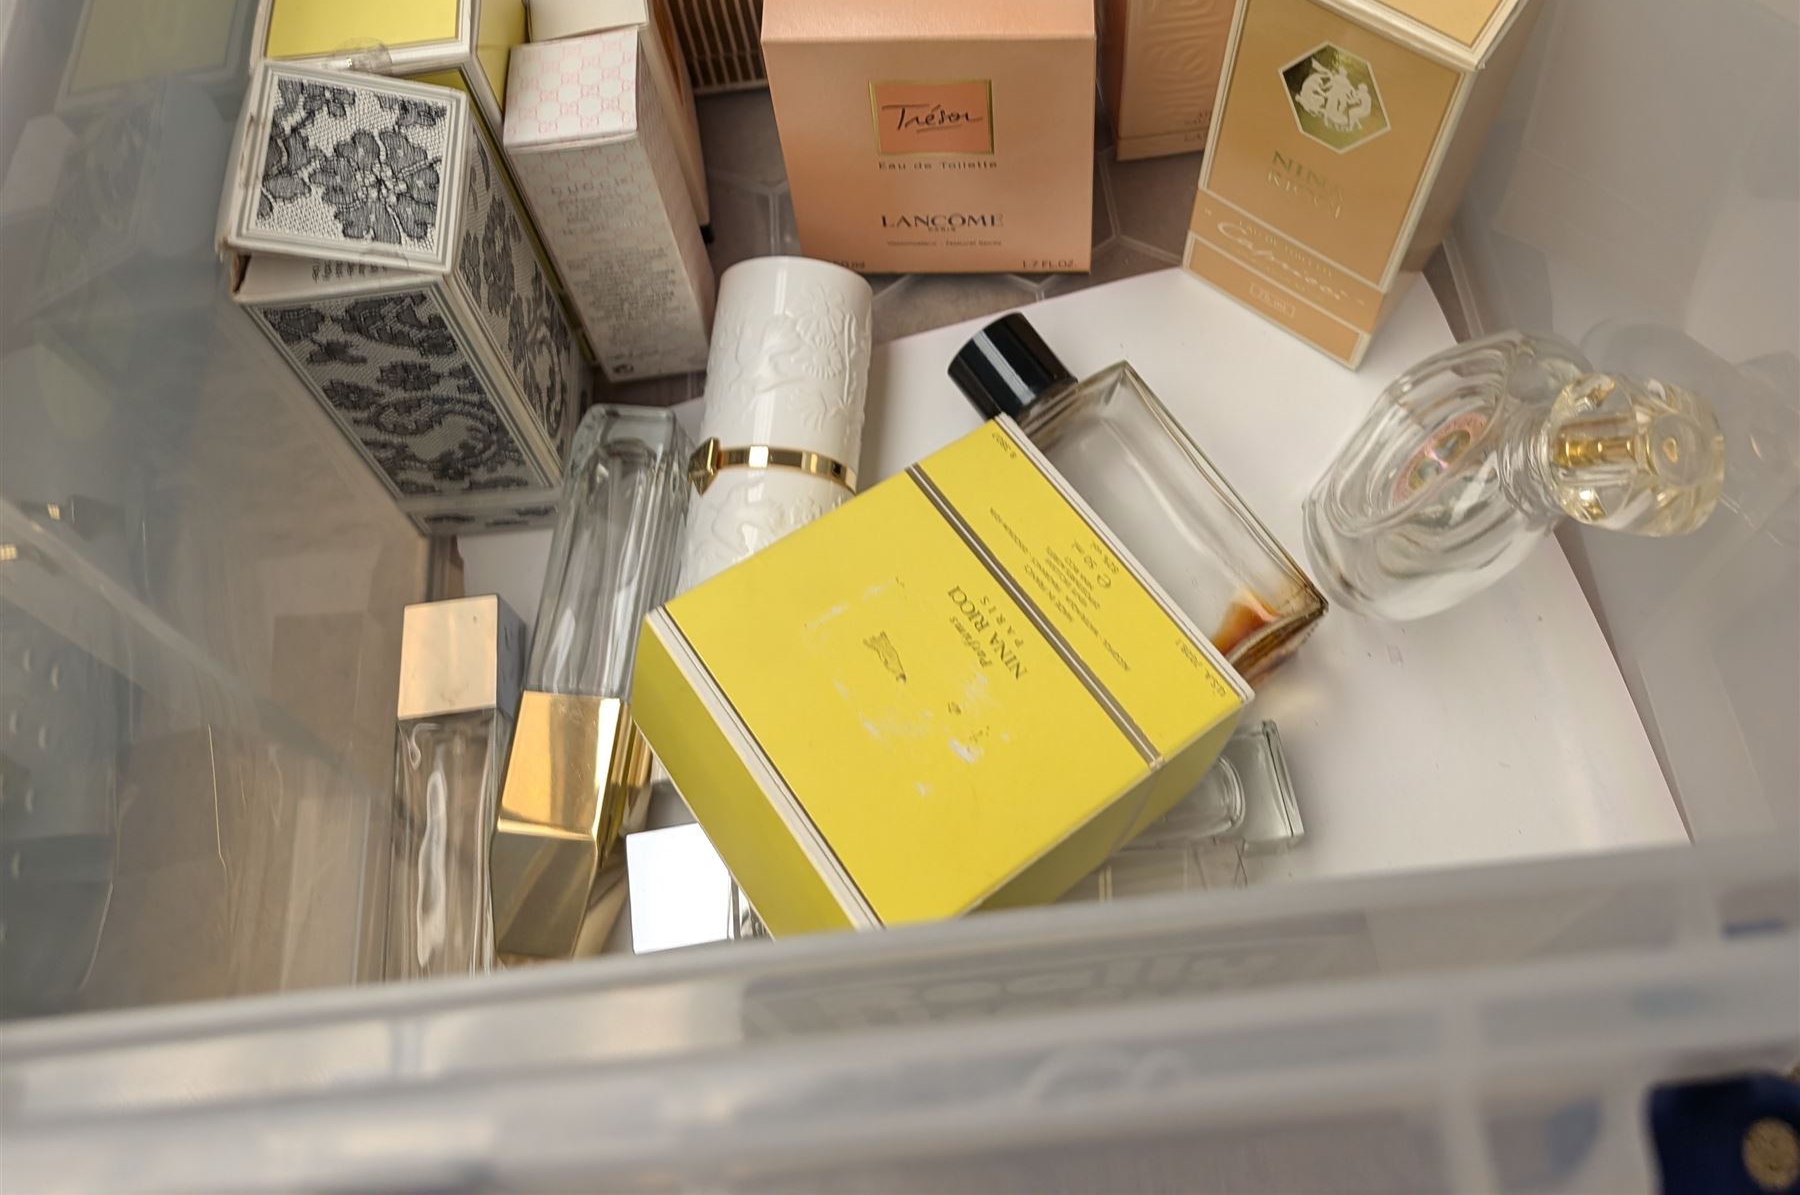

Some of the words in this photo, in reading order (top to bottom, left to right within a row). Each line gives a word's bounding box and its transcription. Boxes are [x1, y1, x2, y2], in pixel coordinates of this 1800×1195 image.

[882, 104, 983, 132] Trésor
[879, 161, 906, 169] Eau
[913, 161, 933, 169] de
[941, 161, 998, 169] Toilette
[1272, 150, 1344, 204] NINA
[947, 585, 990, 632] RICCI
[979, 595, 1024, 648] PARIS
[949, 615, 992, 668] Parfums
[989, 631, 1028, 680] NINA
